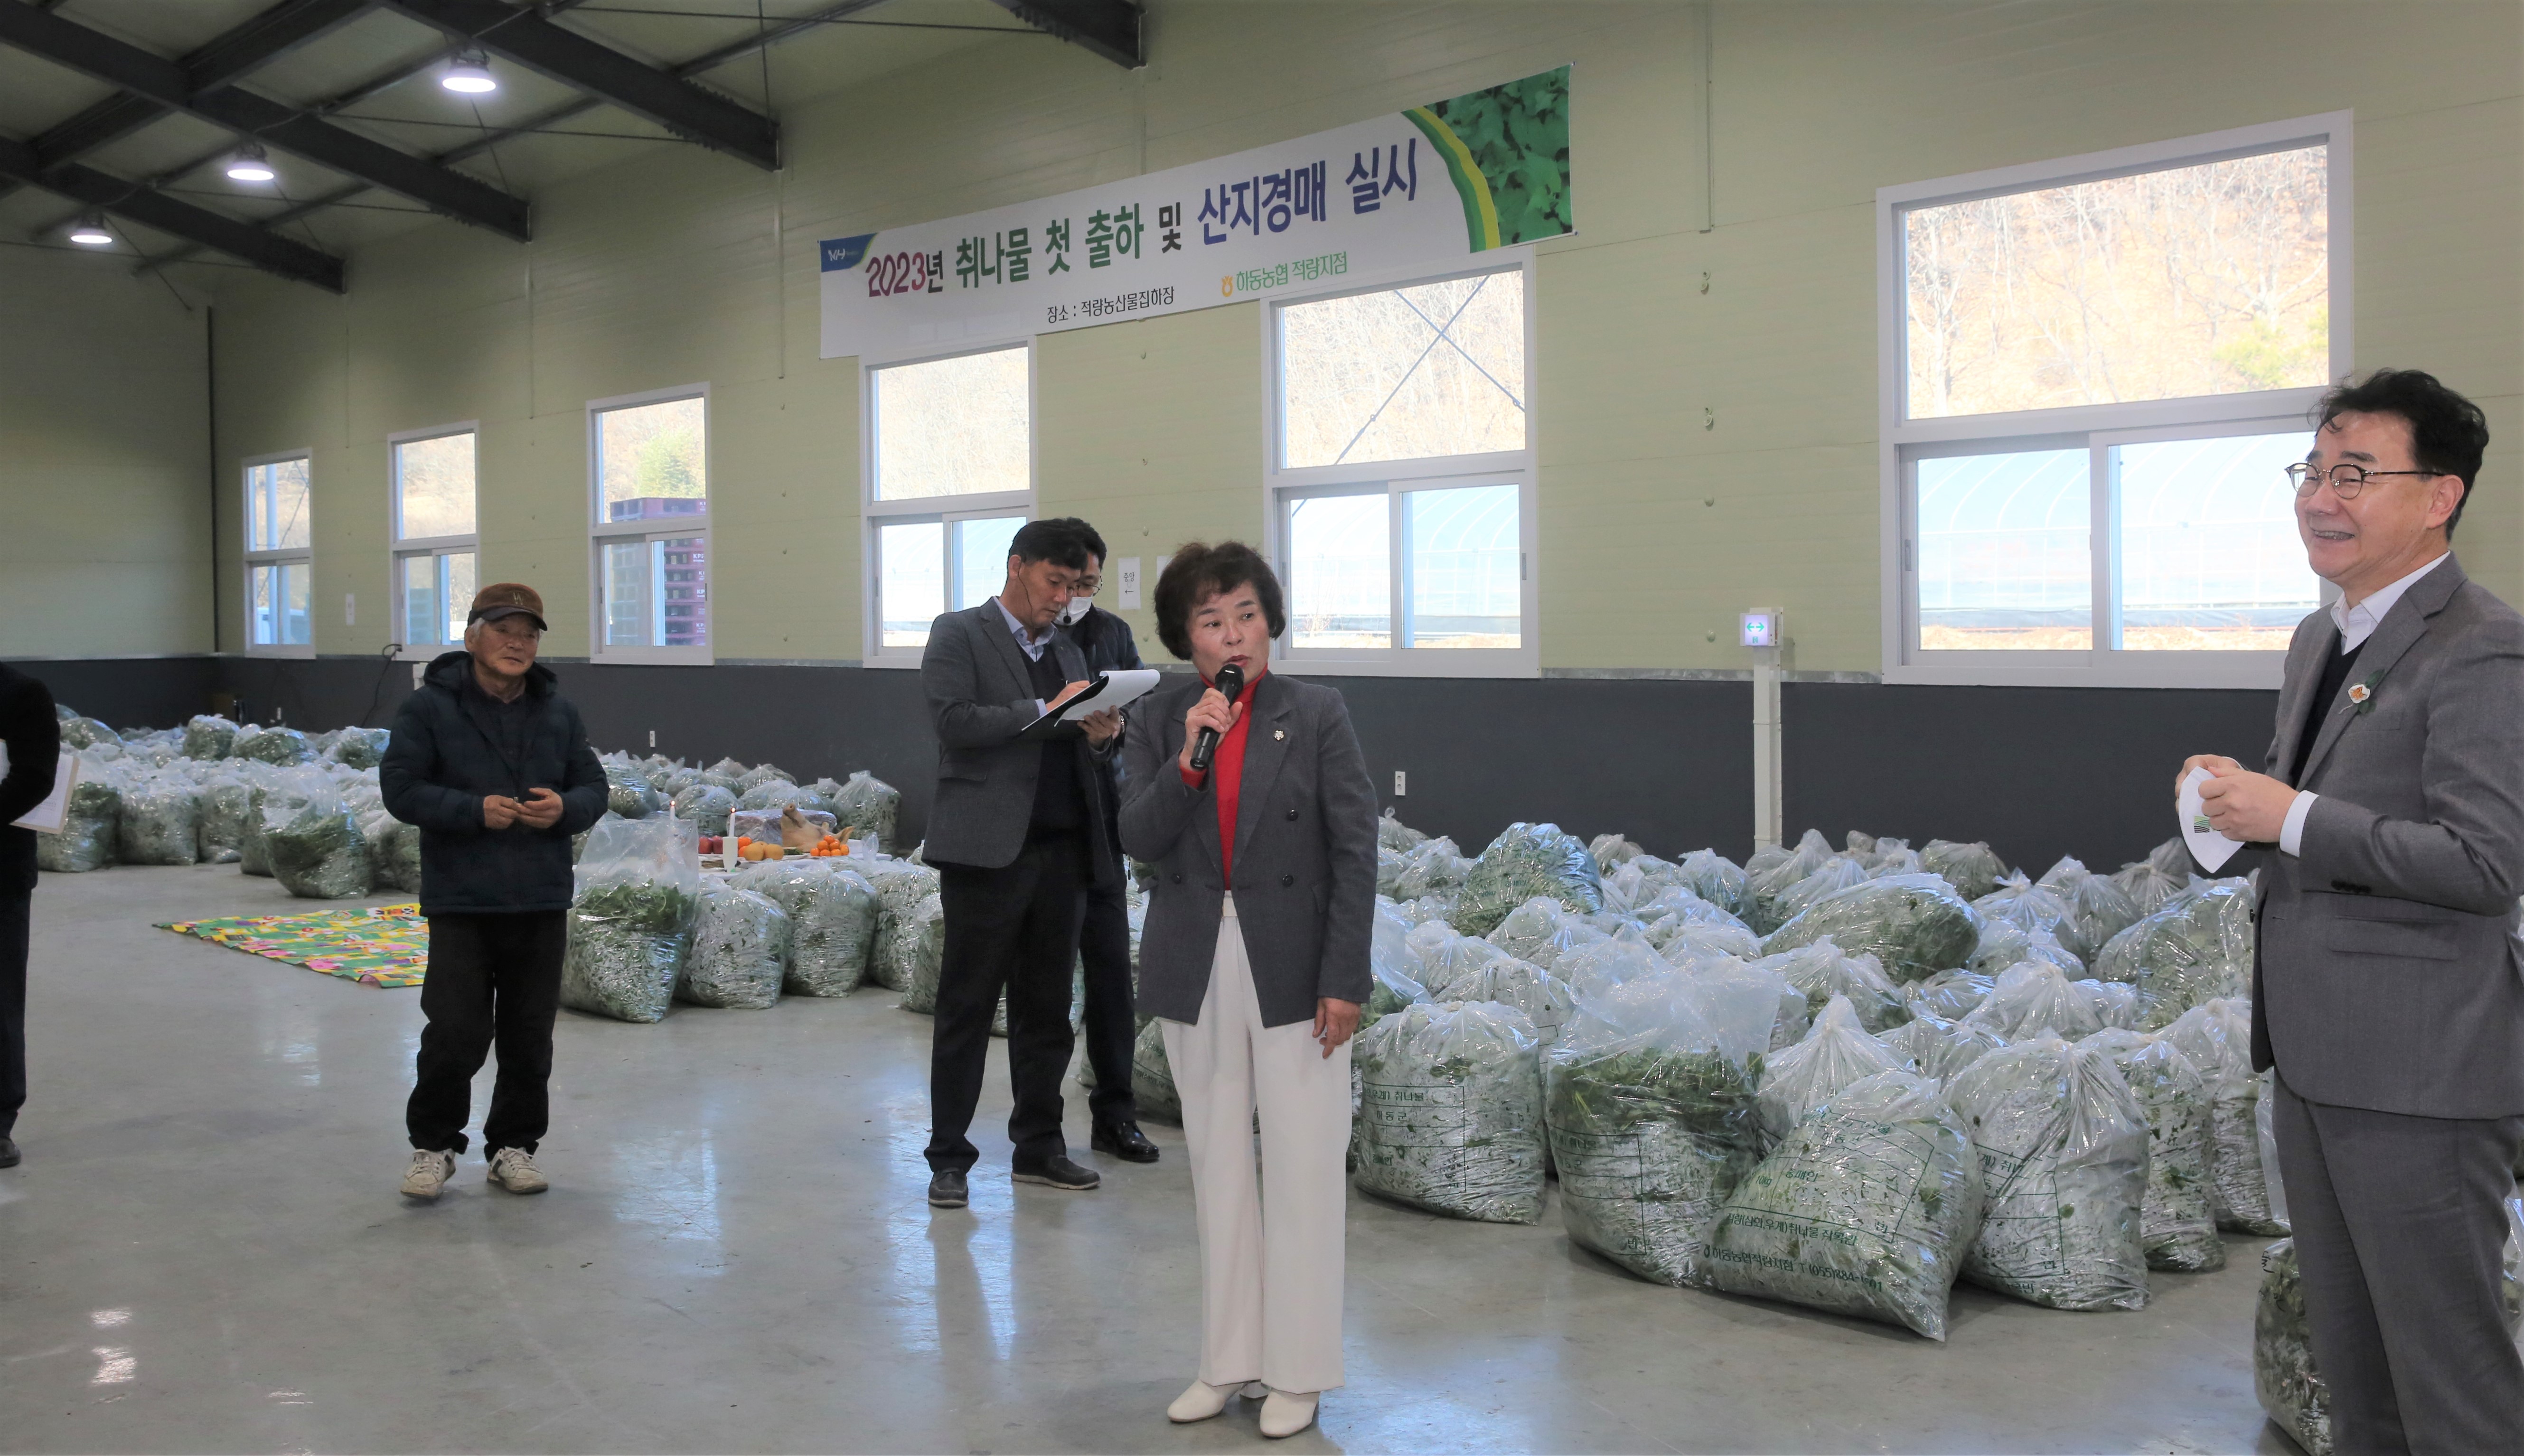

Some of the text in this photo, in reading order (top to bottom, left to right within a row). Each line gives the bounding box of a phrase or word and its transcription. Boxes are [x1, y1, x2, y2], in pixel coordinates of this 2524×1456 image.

[865, 138, 1417, 297] 2023년 취나물 첫 출하 및 산지경매 실시
[827, 248, 845, 261] NH
[1236, 251, 1347, 291] 하동농협 적량지점
[1047, 305, 1069, 323] 장소
[1081, 286, 1175, 317] 적량농산물집하장
[1124, 572, 1135, 582] 중앙
[1756, 1176, 1773, 1186] 10kg
